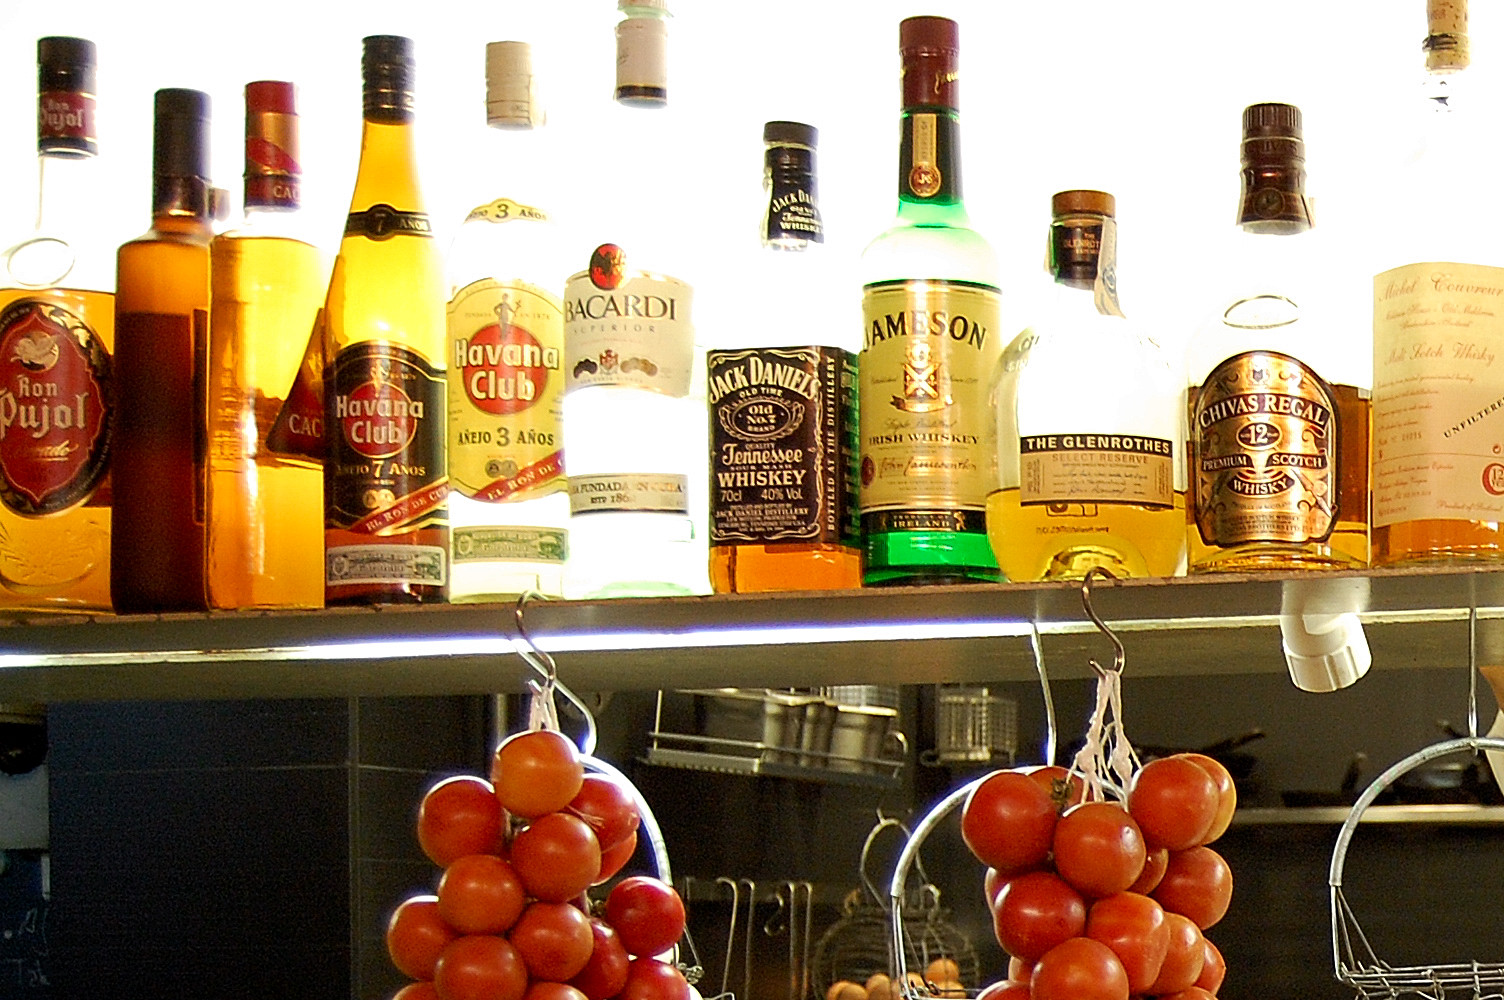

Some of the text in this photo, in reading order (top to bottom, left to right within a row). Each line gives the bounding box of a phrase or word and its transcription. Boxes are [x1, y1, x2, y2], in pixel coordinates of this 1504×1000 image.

[495, 203, 509, 219] 3
[772, 192, 798, 213] JACK
[565, 294, 677, 323] BACARDI
[863, 311, 986, 353] JAMESON
[455, 339, 559, 370] Havana
[1453, 342, 1495, 368] Whisky
[18, 374, 58, 399] Ron
[471, 370, 535, 400] Club
[709, 365, 749, 404] JACK
[739, 386, 783, 398] OLD TIME
[0, 392, 89, 439] Pujol
[335, 395, 425, 419] Havana
[748, 405, 773, 415] Old
[1200, 394, 1326, 428] CHIVAS REGAL
[351, 421, 401, 446] Club
[457, 426, 554, 448] AÑEJO 3 AÑOS
[826, 356, 836, 531] BOTTLED AT THE DISTILLERY
[869, 433, 979, 446] IRISH WHISKEY
[1026, 435, 1170, 454] THE GLENROTHES
[1248, 423, 1268, 445] 12
[722, 443, 803, 466] Tennessee
[1052, 453, 1149, 464] SELECT RESERVE
[1202, 454, 1323, 471] PREMIUM SCOTCH
[372, 460, 384, 478] 7
[507, 471, 535, 490] RON
[538, 463, 555, 476] DE
[717, 469, 807, 488] WHISKEY
[1493, 468, 1504, 480] 12
[721, 489, 742, 502] 70cl
[761, 487, 784, 500] 40%
[1233, 477, 1289, 495] WHISKY
[610, 494, 634, 503] 186
[365, 497, 427, 532] EL RON DE
[893, 520, 950, 528] IRELAND
